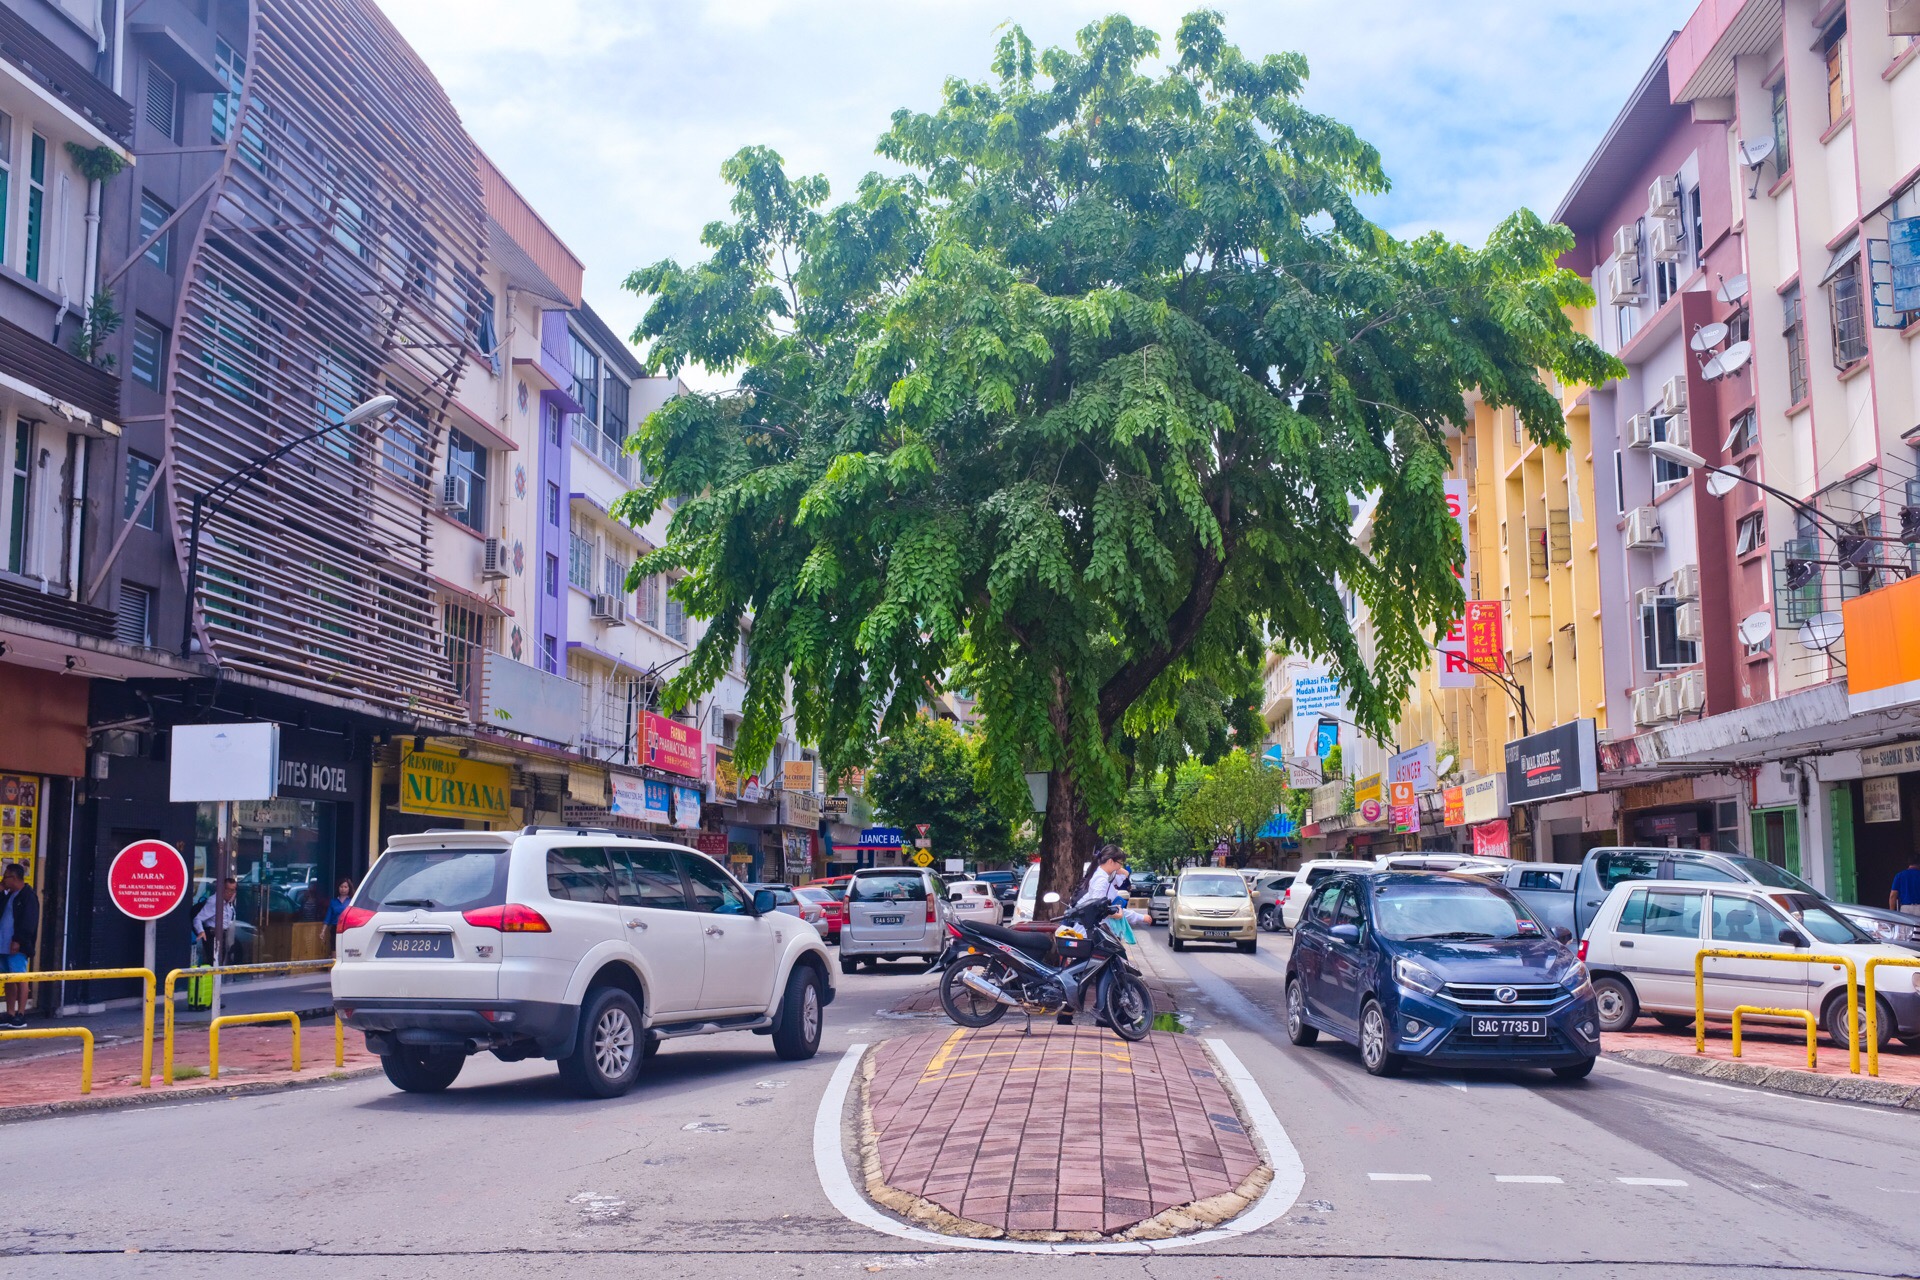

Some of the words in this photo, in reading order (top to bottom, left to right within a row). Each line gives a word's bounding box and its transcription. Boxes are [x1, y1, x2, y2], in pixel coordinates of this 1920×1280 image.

[1750, 620, 1767, 628] astro
[1296, 677, 1319, 687] Aplikasi
[1296, 687, 1316, 695] Mudah
[1317, 685, 1329, 693] Alih
[407, 753, 456, 774] RESTORAN
[1536, 751, 1550, 768] BOXES
[1402, 761, 1422, 781] SINGER
[311, 764, 347, 793] HOTEL
[1526, 777, 1540, 787] Business
[1540, 774, 1551, 784] Service
[1551, 773, 1562, 782] Centre
[406, 773, 506, 811] NURYANA
[391, 939, 409, 951] SAB
[411, 939, 432, 951] 228
[433, 939, 441, 951] J
[1477, 1021, 1499, 1032] SAC
[1501, 1020, 1529, 1032] 7735
[1532, 1021, 1539, 1032] D
